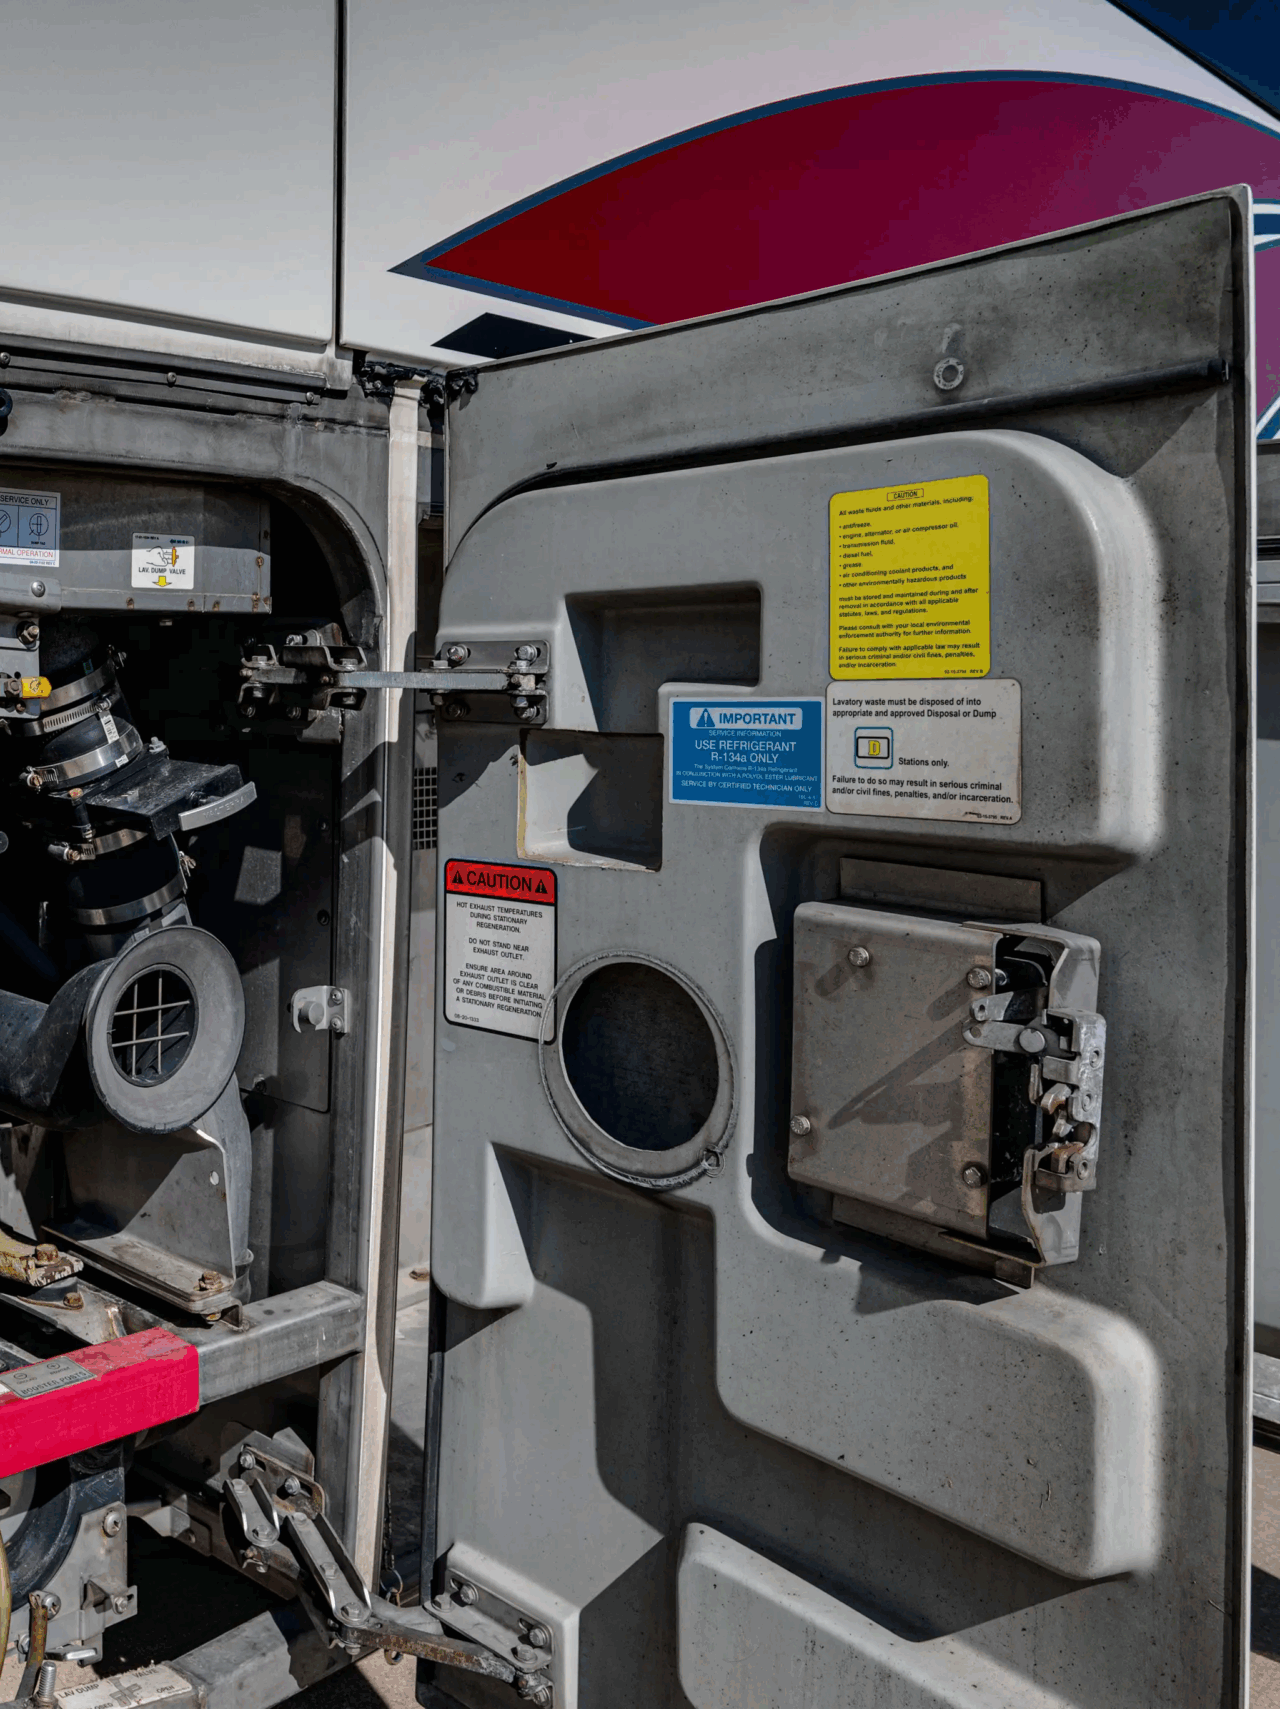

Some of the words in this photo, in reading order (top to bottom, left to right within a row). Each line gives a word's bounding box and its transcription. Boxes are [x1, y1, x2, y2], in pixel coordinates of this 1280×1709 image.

[0, 495, 30, 504] SERVICE
[31, 498, 49, 506] ONLY
[894, 491, 918, 499] CAUTION
[16, 549, 54, 558] OPERATION
[832, 698, 863, 707] Lavatory
[887, 698, 906, 706] must
[908, 698, 917, 706] be
[919, 698, 954, 707] disposed
[956, 698, 964, 706] of
[966, 698, 982, 706] into
[719, 713, 796, 725] IMPORTANT
[832, 710, 873, 718] appropriate
[874, 709, 888, 717] and
[890, 710, 925, 718] approved
[927, 709, 961, 718] Disposal
[973, 709, 997, 719] Dump
[695, 740, 716, 750] USE
[719, 740, 797, 751] REFRIGERANT
[868, 740, 881, 756] D
[711, 752, 747, 762] R-134a
[750, 753, 779, 763] ONLY
[898, 757, 929, 766] Stations
[753, 783, 793, 791] TECHNICIAN
[832, 775, 856, 784] Failure
[867, 777, 877, 785] do
[889, 779, 905, 788] may
[906, 779, 928, 787] result
[939, 781, 968, 789] serious
[970, 782, 1002, 791] criminal
[832, 787, 855, 795] and/or
[932, 792, 957, 800] and/or
[466, 871, 532, 892] CAUTION
[469, 903, 495, 912] EXHAUST
[497, 907, 543, 918] TEMPERATURES
[470, 912, 491, 920] DURING
[493, 915, 528, 924] STATIONARY
[473, 947, 499, 956] EXHAUST
[493, 941, 511, 950] STAND
[513, 944, 529, 952] NEAR
[466, 963, 488, 972] ENSURE
[490, 967, 506, 975] AREA
[507, 970, 532, 980] AROUND
[460, 970, 485, 980] EXHAUST
[487, 975, 509, 984] OUTLET
[519, 981, 539, 990] CLEAR
[475, 982, 515, 995] COMBUSTIBLE
[517, 990, 546, 1000] MATERIAL
[462, 997, 495, 1008] STATIONARY
[466, 989, 487, 998] DEBRIS
[488, 993, 511, 1003] BEFORE
[513, 998, 543, 1009] INITIATING
[20, 1381, 60, 1395] BOOSTER
[60, 1371, 87, 1383] POSTS
[58, 1689, 75, 1699] LAV
[75, 1683, 100, 1695] DUMP
[132, 1668, 158, 1678] VALVE
[156, 1685, 175, 1694] OPEN
